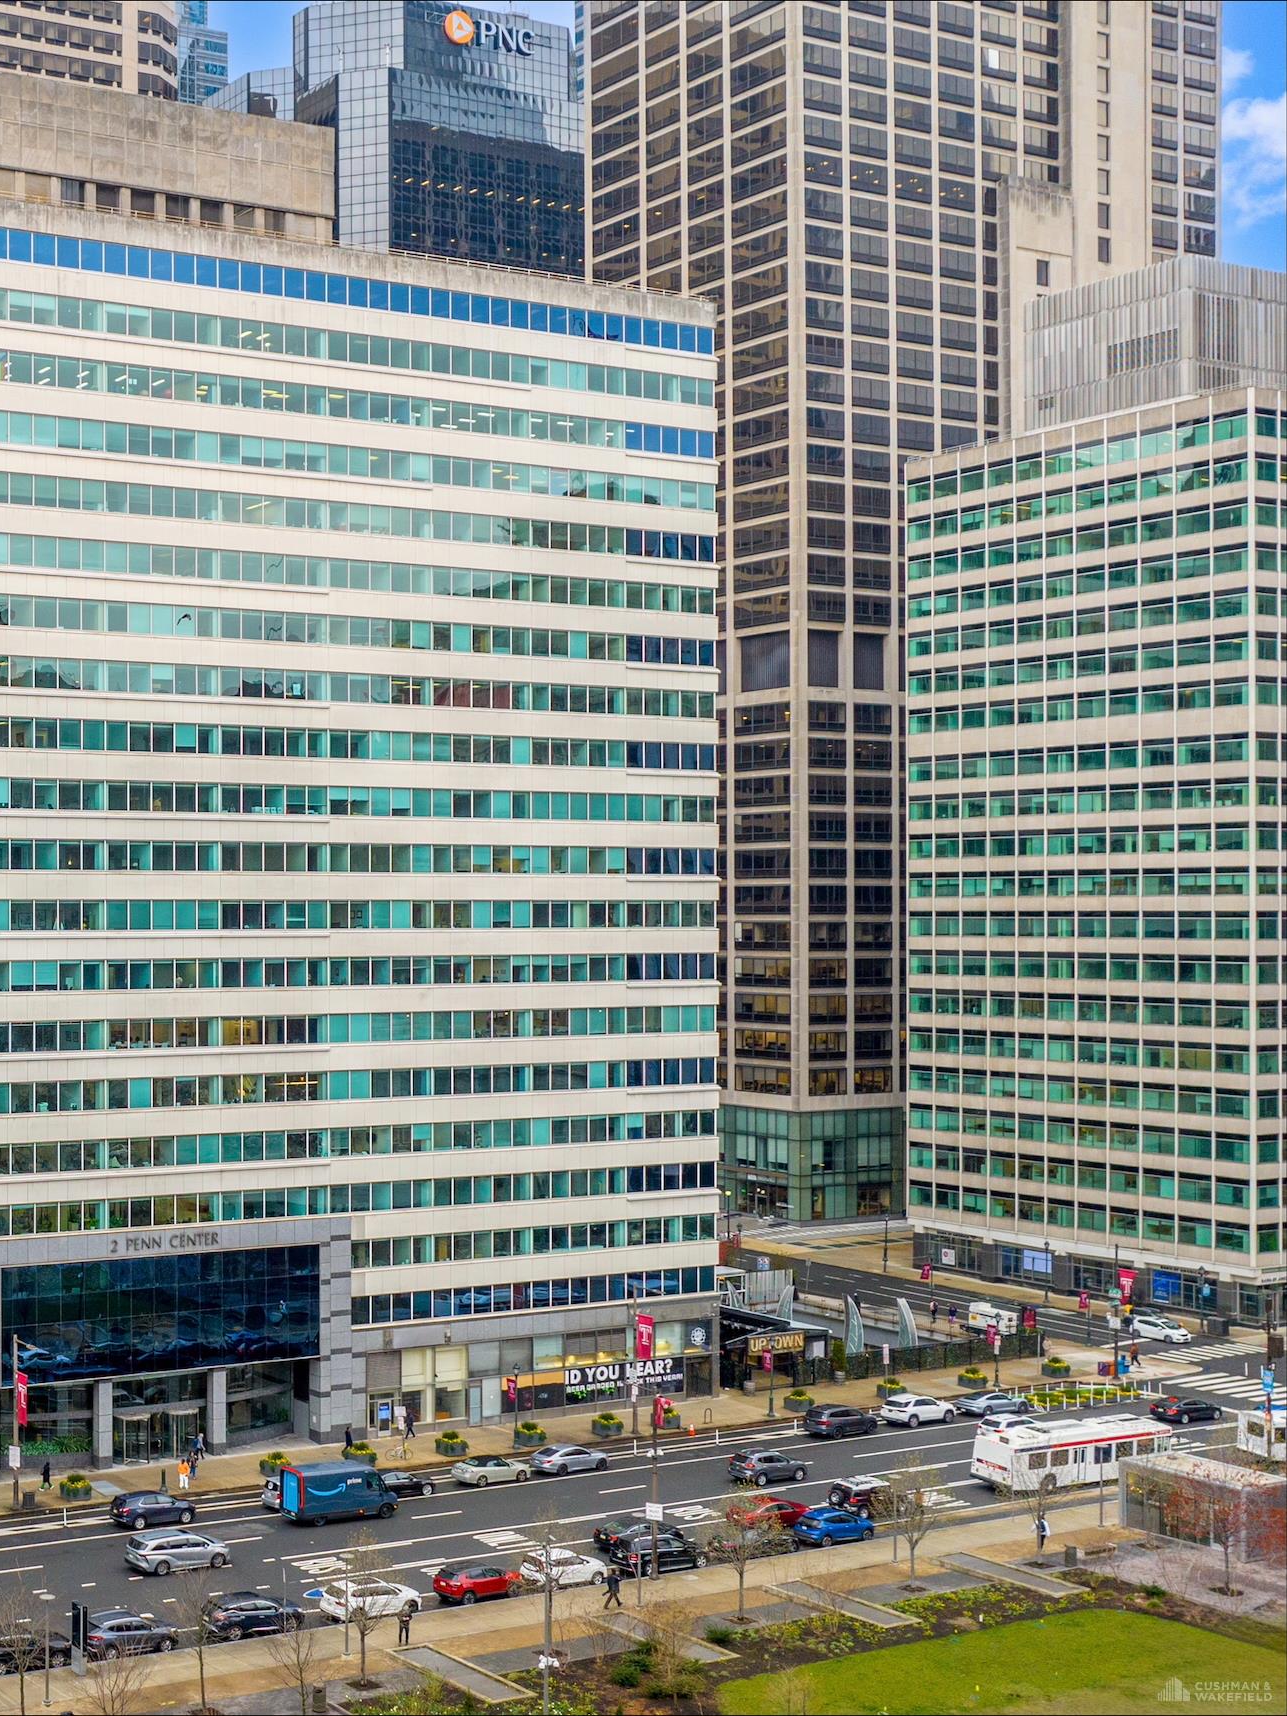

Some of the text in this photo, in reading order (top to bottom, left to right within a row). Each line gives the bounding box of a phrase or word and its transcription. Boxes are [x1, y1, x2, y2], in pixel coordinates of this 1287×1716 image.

[478, 18, 535, 55] PNC
[110, 1231, 219, 1253] 2 PENN CENTER
[585, 1365, 620, 1382] YOU
[347, 1477, 362, 1485] prime
